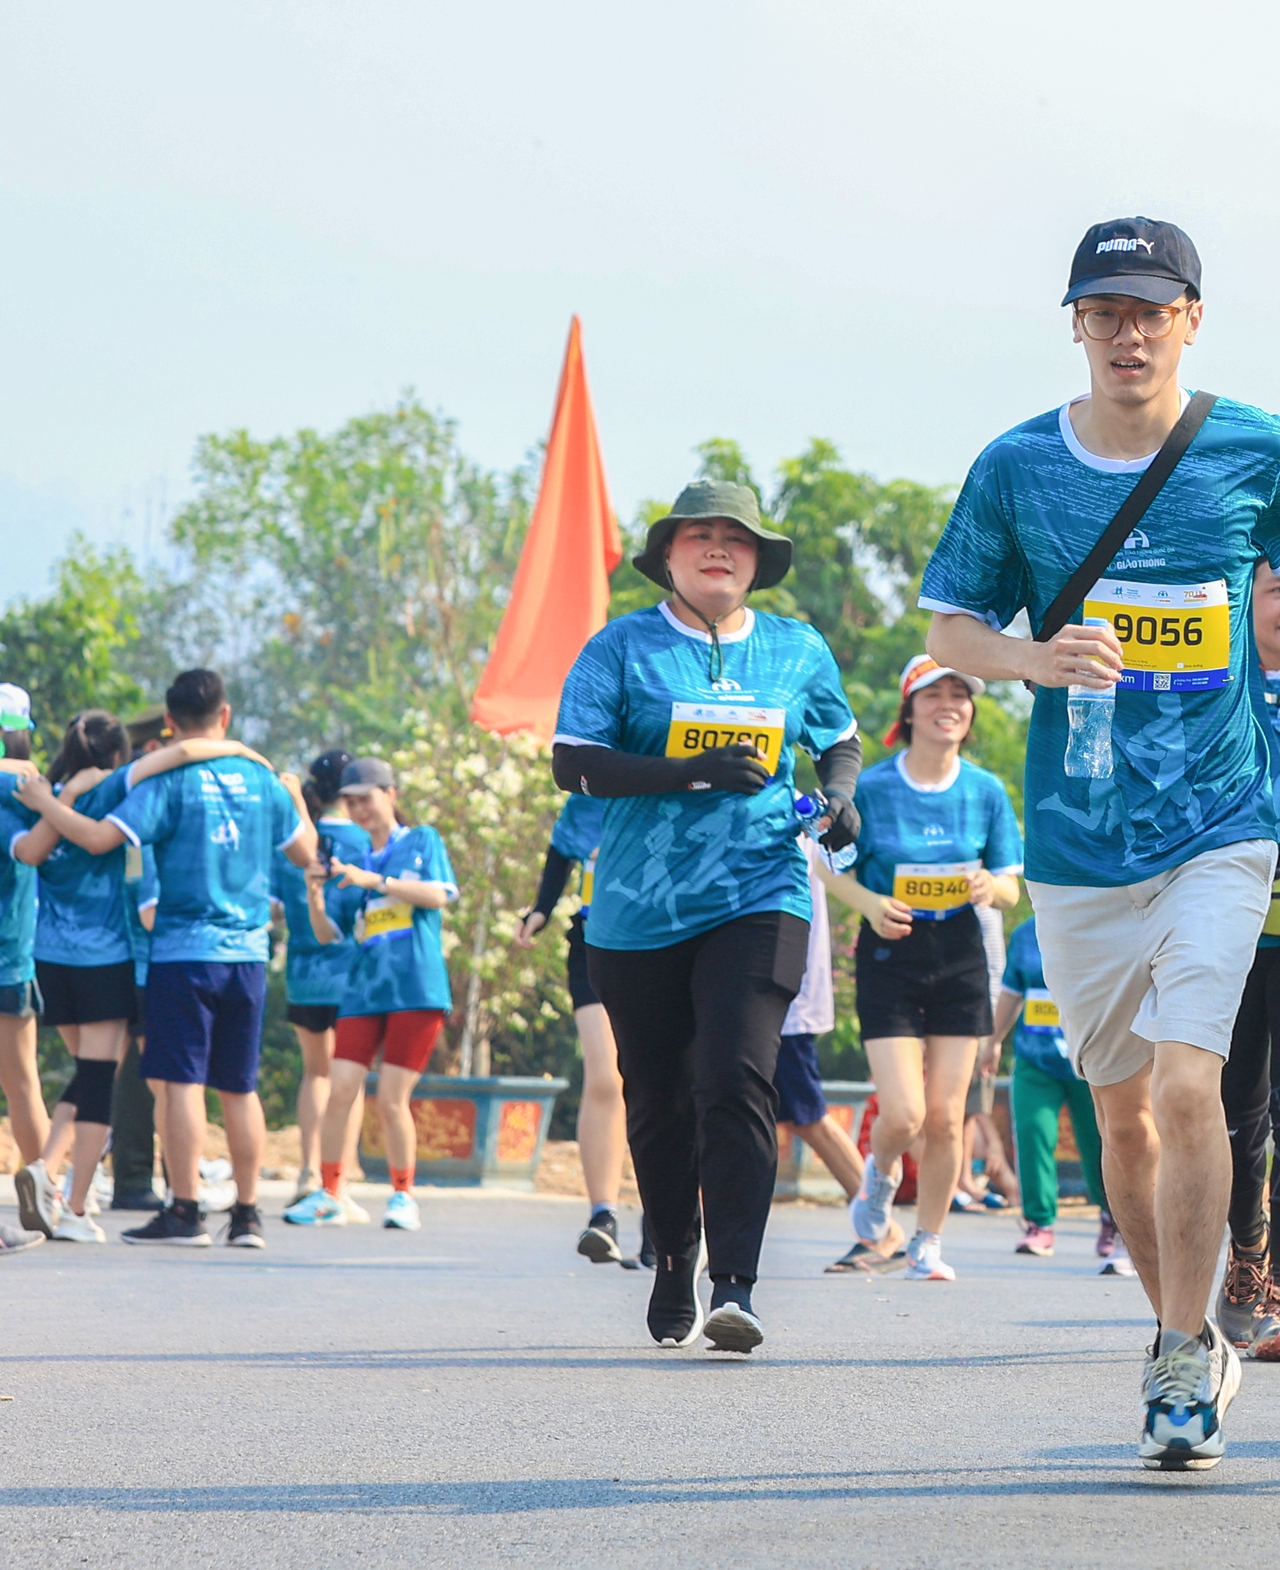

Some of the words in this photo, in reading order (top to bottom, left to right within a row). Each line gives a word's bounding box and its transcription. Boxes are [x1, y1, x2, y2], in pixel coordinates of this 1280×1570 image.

[1096, 238, 1137, 254] PUMA
[1114, 613, 1203, 647] 9056
[905, 880, 969, 897] 80340
